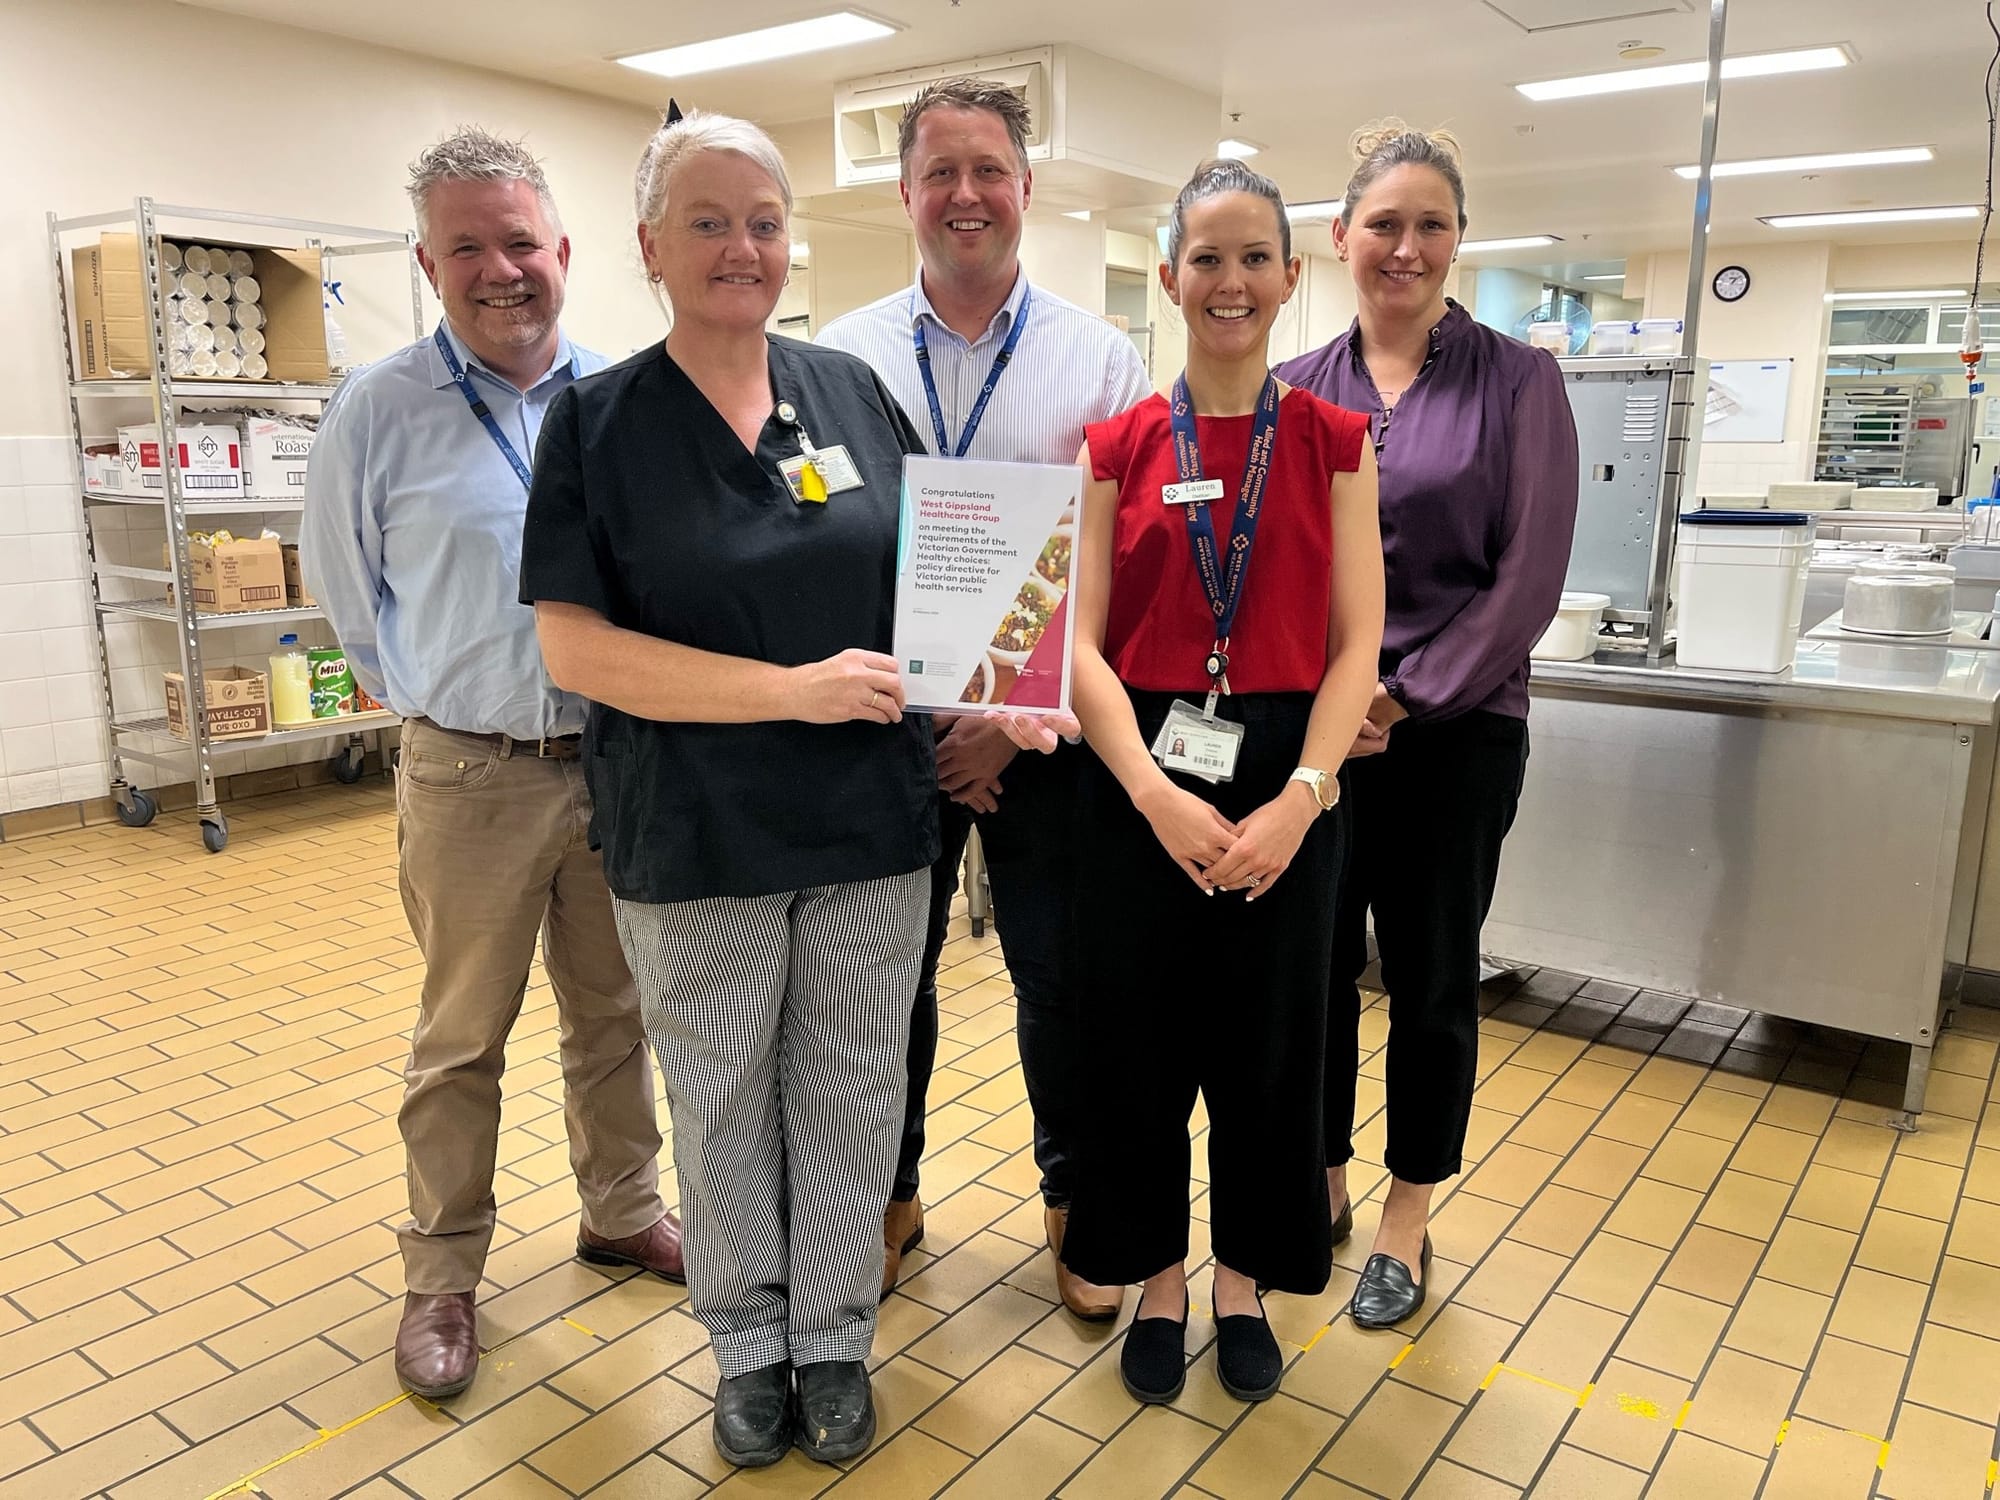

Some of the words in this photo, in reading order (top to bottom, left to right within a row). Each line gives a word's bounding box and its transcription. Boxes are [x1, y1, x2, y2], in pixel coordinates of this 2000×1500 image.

[1263, 424, 1274, 450] Allied
[1177, 432, 1190, 479] Community
[1250, 435, 1263, 463] Health
[1189, 441, 1199, 477] Manager
[1260, 450, 1268, 466] and
[1185, 484, 1216, 492] Lauren
[1240, 465, 1258, 504] Manager
[921, 488, 995, 500] Congratulations
[1246, 466, 1266, 519] Community
[921, 500, 942, 508] West
[945, 502, 991, 512] Gippsland
[1187, 502, 1198, 522] Allie
[920, 510, 970, 520] Healthcare
[972, 514, 1000, 523] Group
[932, 526, 969, 535] meeting
[918, 534, 979, 544] requirements
[918, 543, 960, 552] Victorian
[961, 546, 1018, 556] Government
[916, 553, 952, 563] Healthy
[954, 556, 990, 564] choices:
[1235, 553, 1243, 571] WEST
[916, 563, 943, 572] policy
[945, 565, 985, 574] directive
[916, 573, 958, 582] Victorian
[960, 576, 988, 584] public
[915, 582, 944, 591] health
[946, 585, 982, 593] services
[320, 664, 345, 675] MILO
